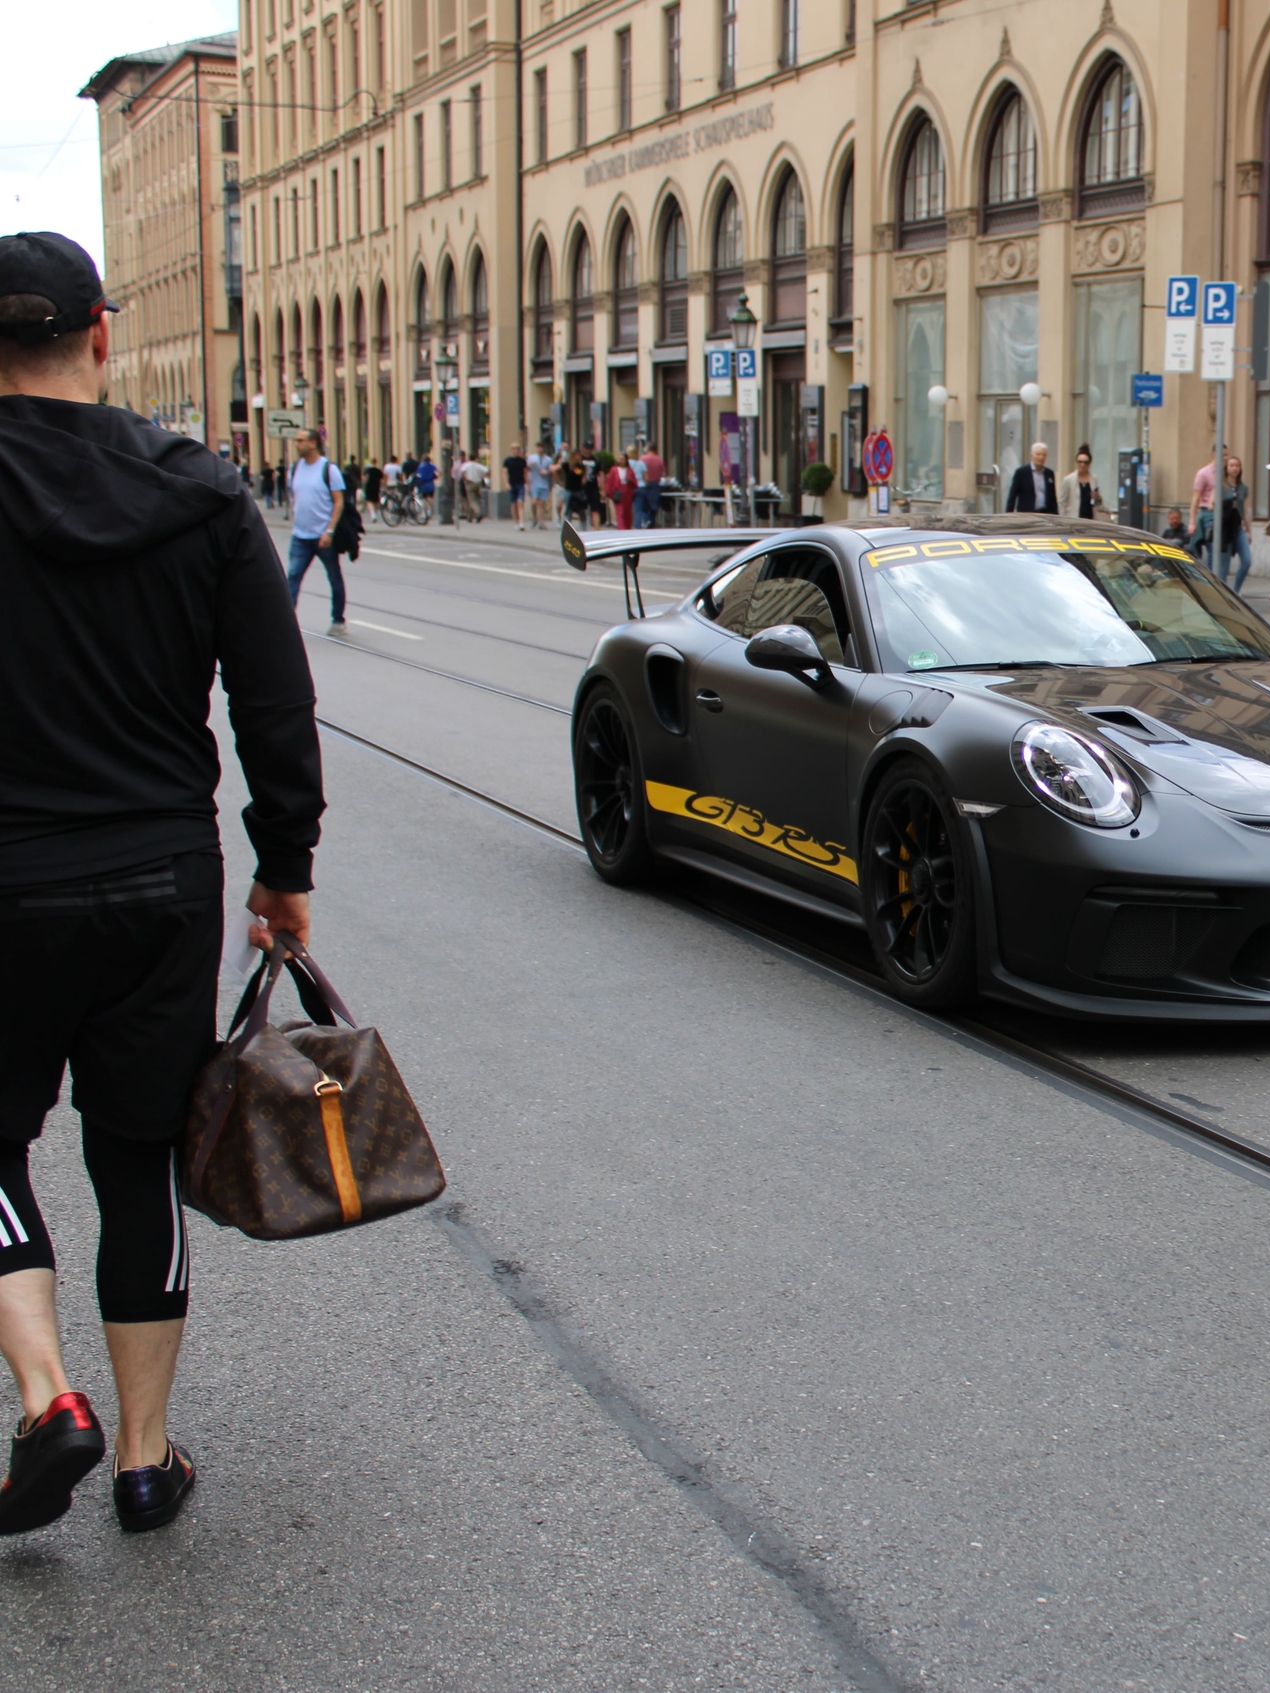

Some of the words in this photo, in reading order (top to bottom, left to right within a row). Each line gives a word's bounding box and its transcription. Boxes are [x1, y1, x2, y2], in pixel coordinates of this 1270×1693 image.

[1171, 281, 1190, 313] P
[1207, 287, 1226, 320] P
[711, 352, 725, 376] P
[739, 352, 751, 376] P
[867, 538, 1195, 568] PORSCHE
[684, 793, 766, 837] GT3
[771, 824, 847, 866] RS
